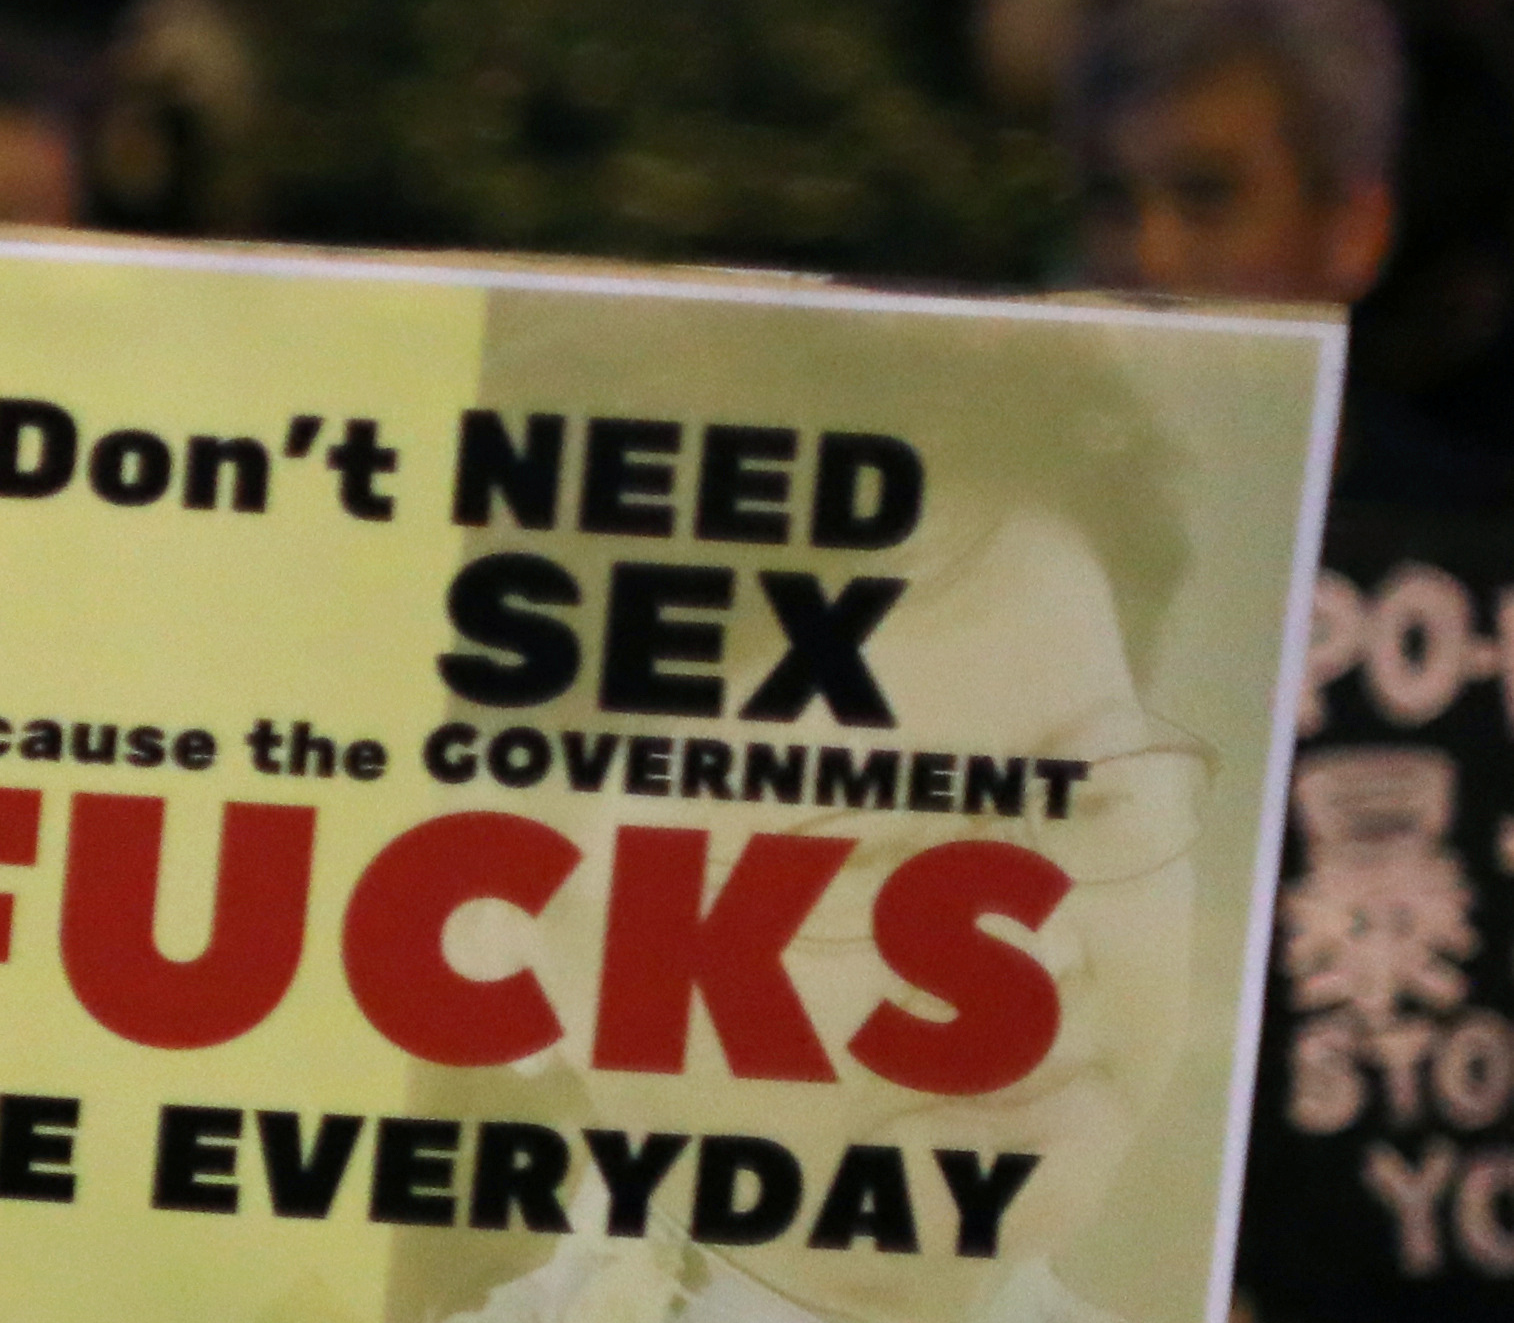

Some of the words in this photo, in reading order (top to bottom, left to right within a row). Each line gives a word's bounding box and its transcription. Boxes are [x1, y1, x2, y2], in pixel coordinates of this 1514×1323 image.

[454, 410, 925, 551] NEED
[439, 552, 905, 727] SEX
[1300, 560, 1514, 738] PO-
[250, 722, 386, 779] the
[425, 722, 1087, 818] GOVERNMENT
[153, 1106, 1039, 1257] EVERYDAY
